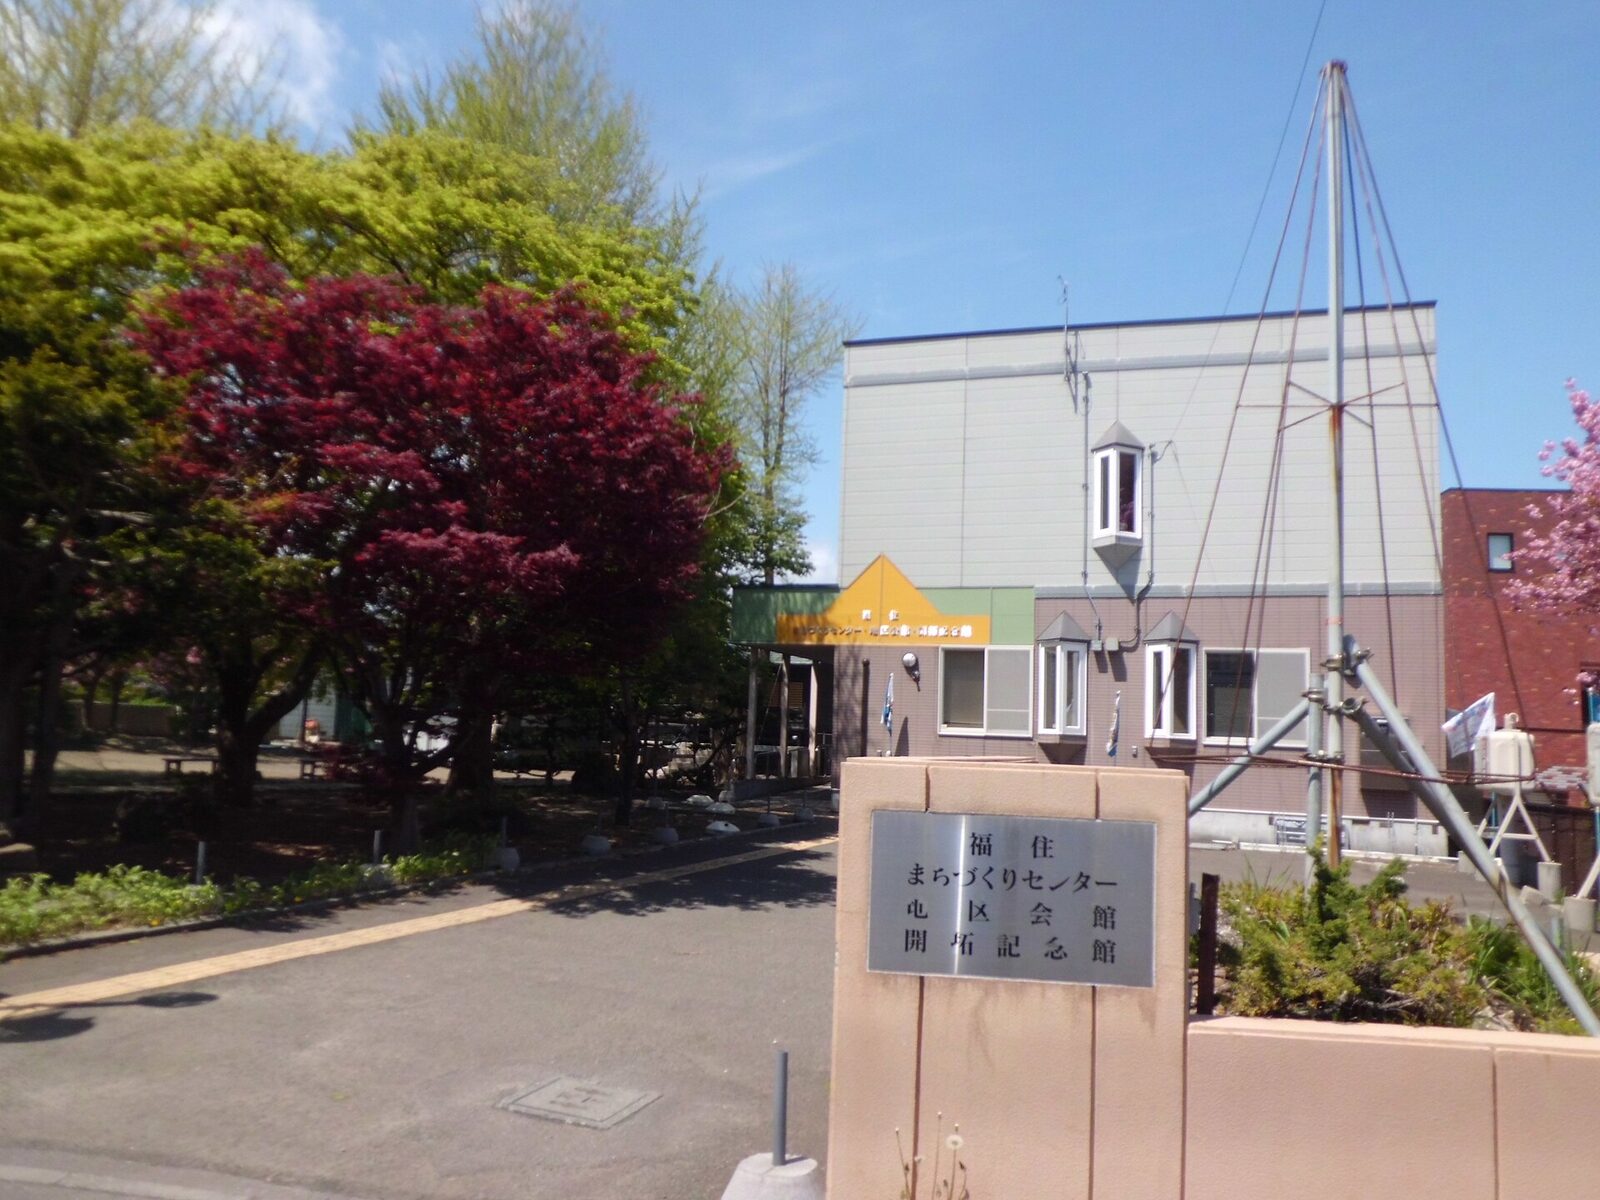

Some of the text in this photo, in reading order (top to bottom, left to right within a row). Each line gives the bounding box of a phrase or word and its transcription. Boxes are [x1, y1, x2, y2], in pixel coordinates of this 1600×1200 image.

[969, 832, 1054, 859] 福住
[907, 863, 1117, 893] まちづくりセンター
